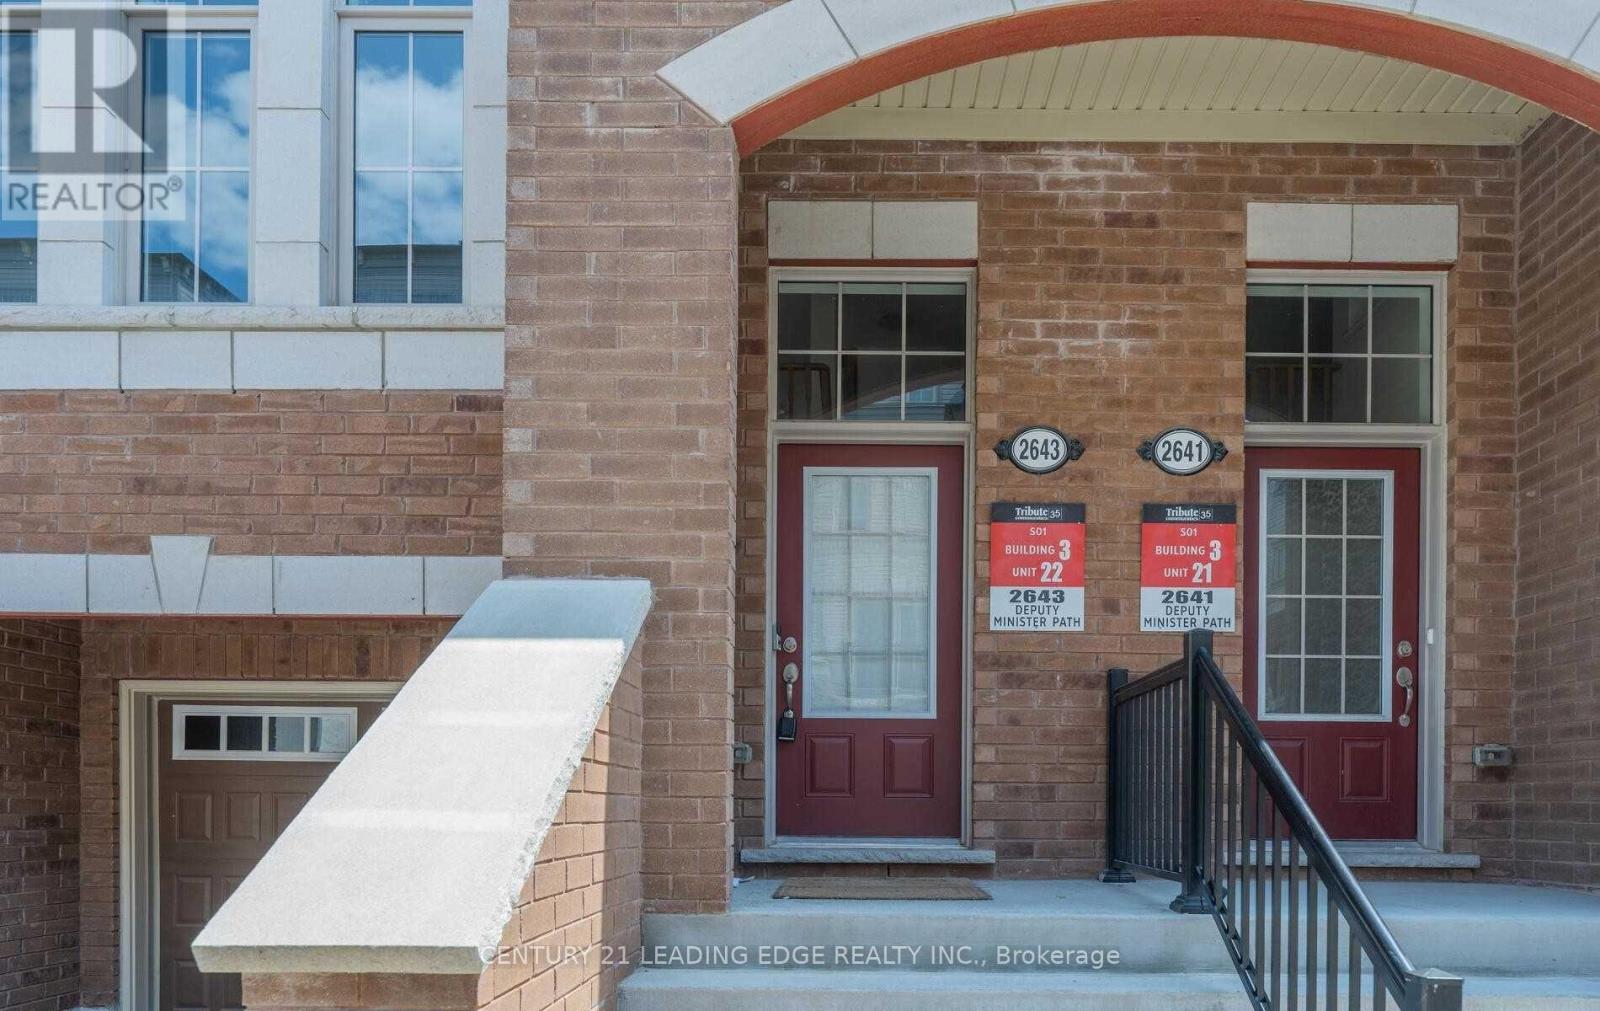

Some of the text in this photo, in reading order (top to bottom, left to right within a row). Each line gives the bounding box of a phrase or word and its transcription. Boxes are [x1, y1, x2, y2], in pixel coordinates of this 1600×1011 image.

[1019, 438, 1060, 461] 2643
[1161, 440, 1203, 462] 2641
[1015, 506, 1048, 516] Tribute
[1050, 510, 1060, 519] 35
[1166, 507, 1199, 517] Tribute
[1201, 511, 1211, 519] 35
[1005, 539, 1071, 560] BUILDING 3
[1155, 540, 1221, 561] BUILDING 3
[1012, 562, 1063, 582] UNIT 22
[1164, 562, 1212, 583] UNIT 21
[1009, 589, 1065, 604] 2643
[1161, 590, 1213, 604] 2641
[1015, 605, 1059, 615] DEPUTY
[1165, 605, 1210, 616] DEPUTY
[993, 617, 1081, 627] MINISTER PATH
[1143, 618, 1231, 628] MINISTER PATH
